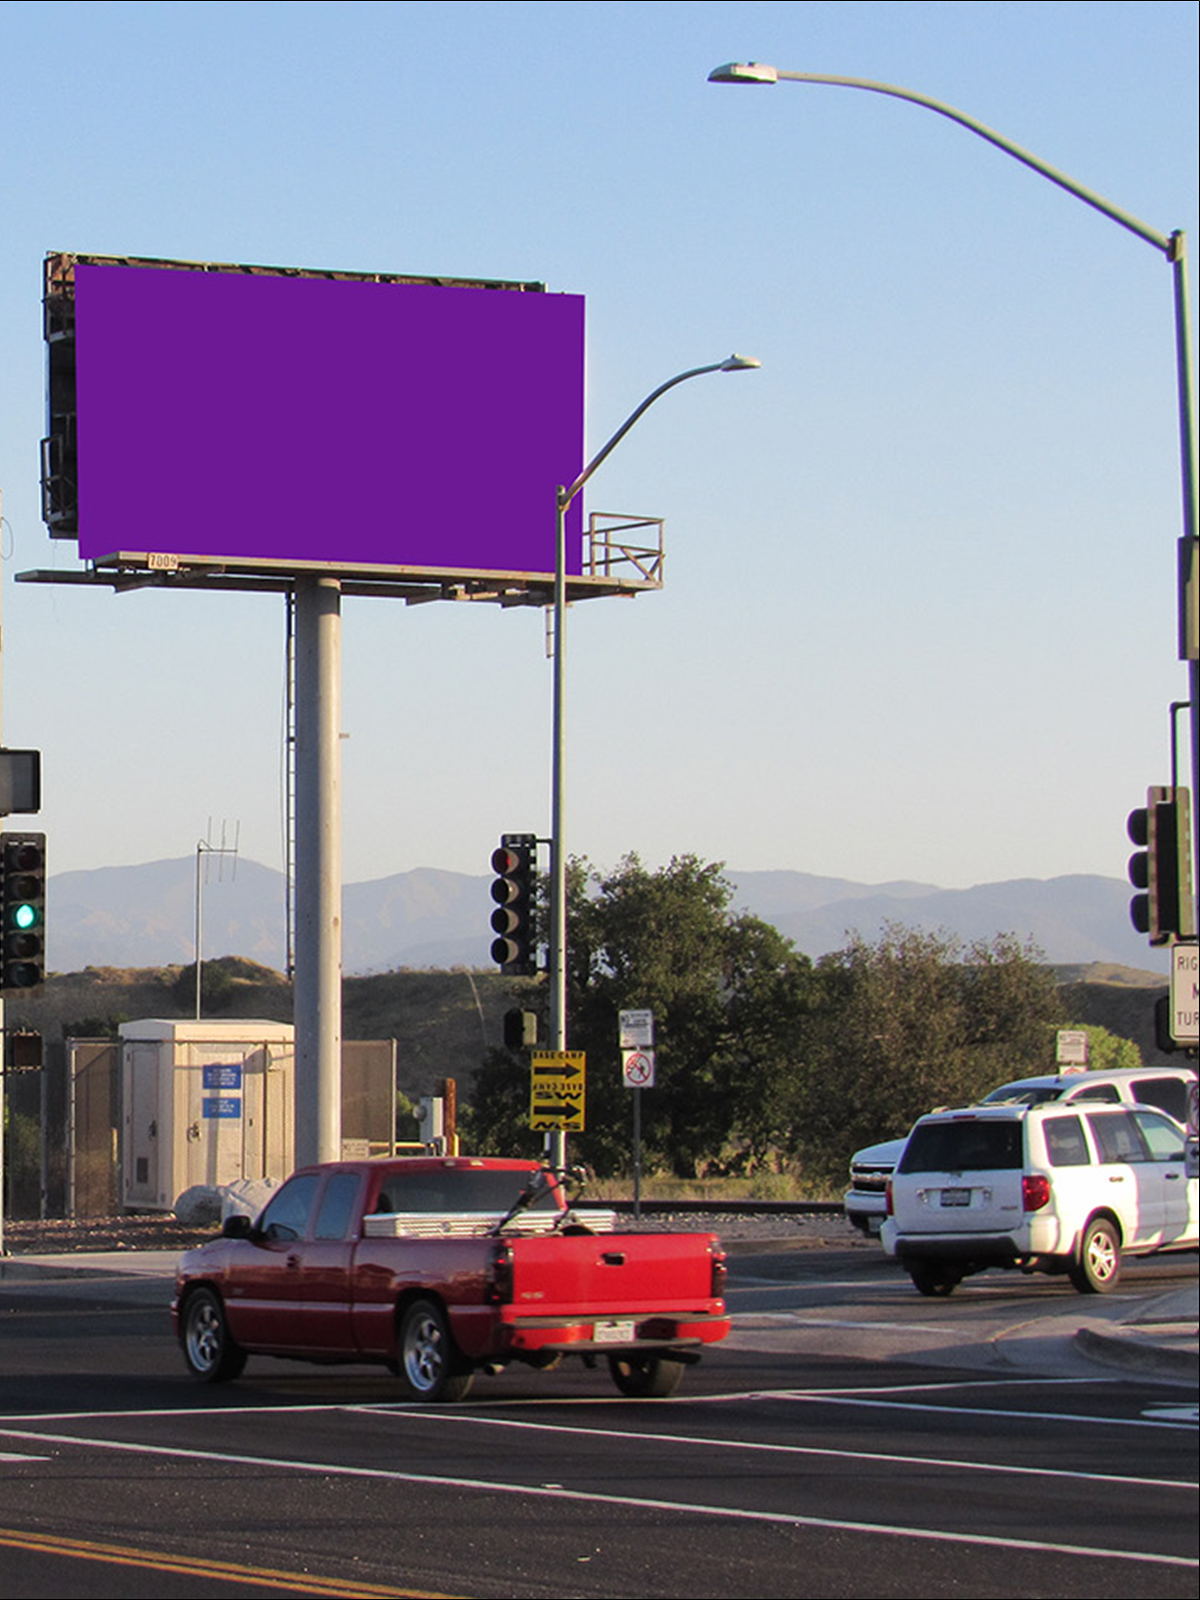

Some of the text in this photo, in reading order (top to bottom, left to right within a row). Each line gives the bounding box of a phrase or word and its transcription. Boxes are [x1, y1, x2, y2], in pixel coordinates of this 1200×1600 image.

[150, 554, 177, 568] 7009
[533, 1051, 583, 1059] BASE CAMP
